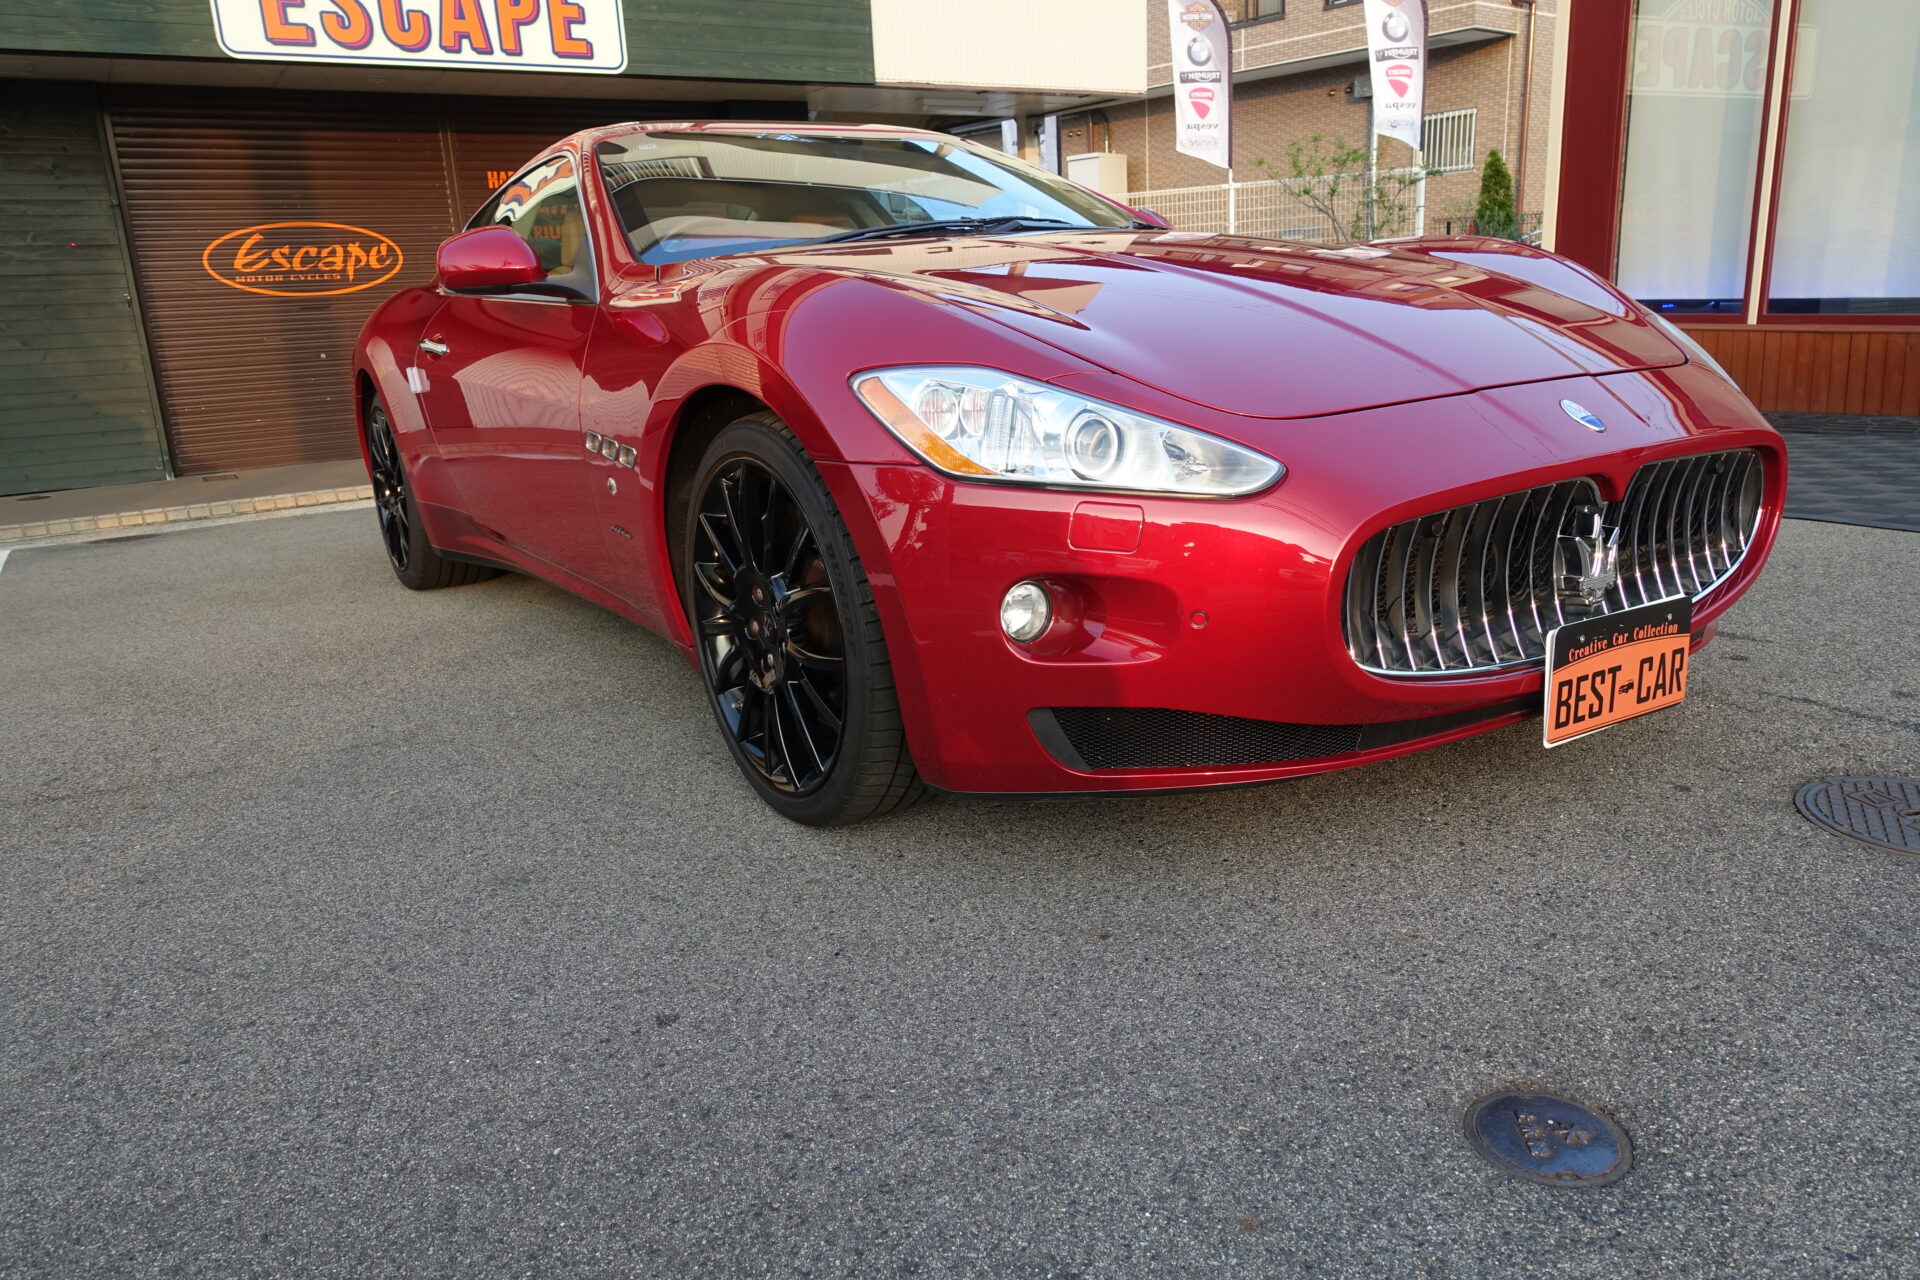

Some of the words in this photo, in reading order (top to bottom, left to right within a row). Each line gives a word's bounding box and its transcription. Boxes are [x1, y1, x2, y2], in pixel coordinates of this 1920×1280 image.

[233, 233, 393, 283] Escape
[235, 274, 283, 283] MOTOR
[289, 273, 341, 281] CYCLES
[1568, 638, 1608, 662] Creative
[1612, 632, 1629, 646] Car
[1633, 622, 1679, 641] Collection
[1554, 664, 1622, 730] BEST
[1636, 647, 1685, 704] CAR
